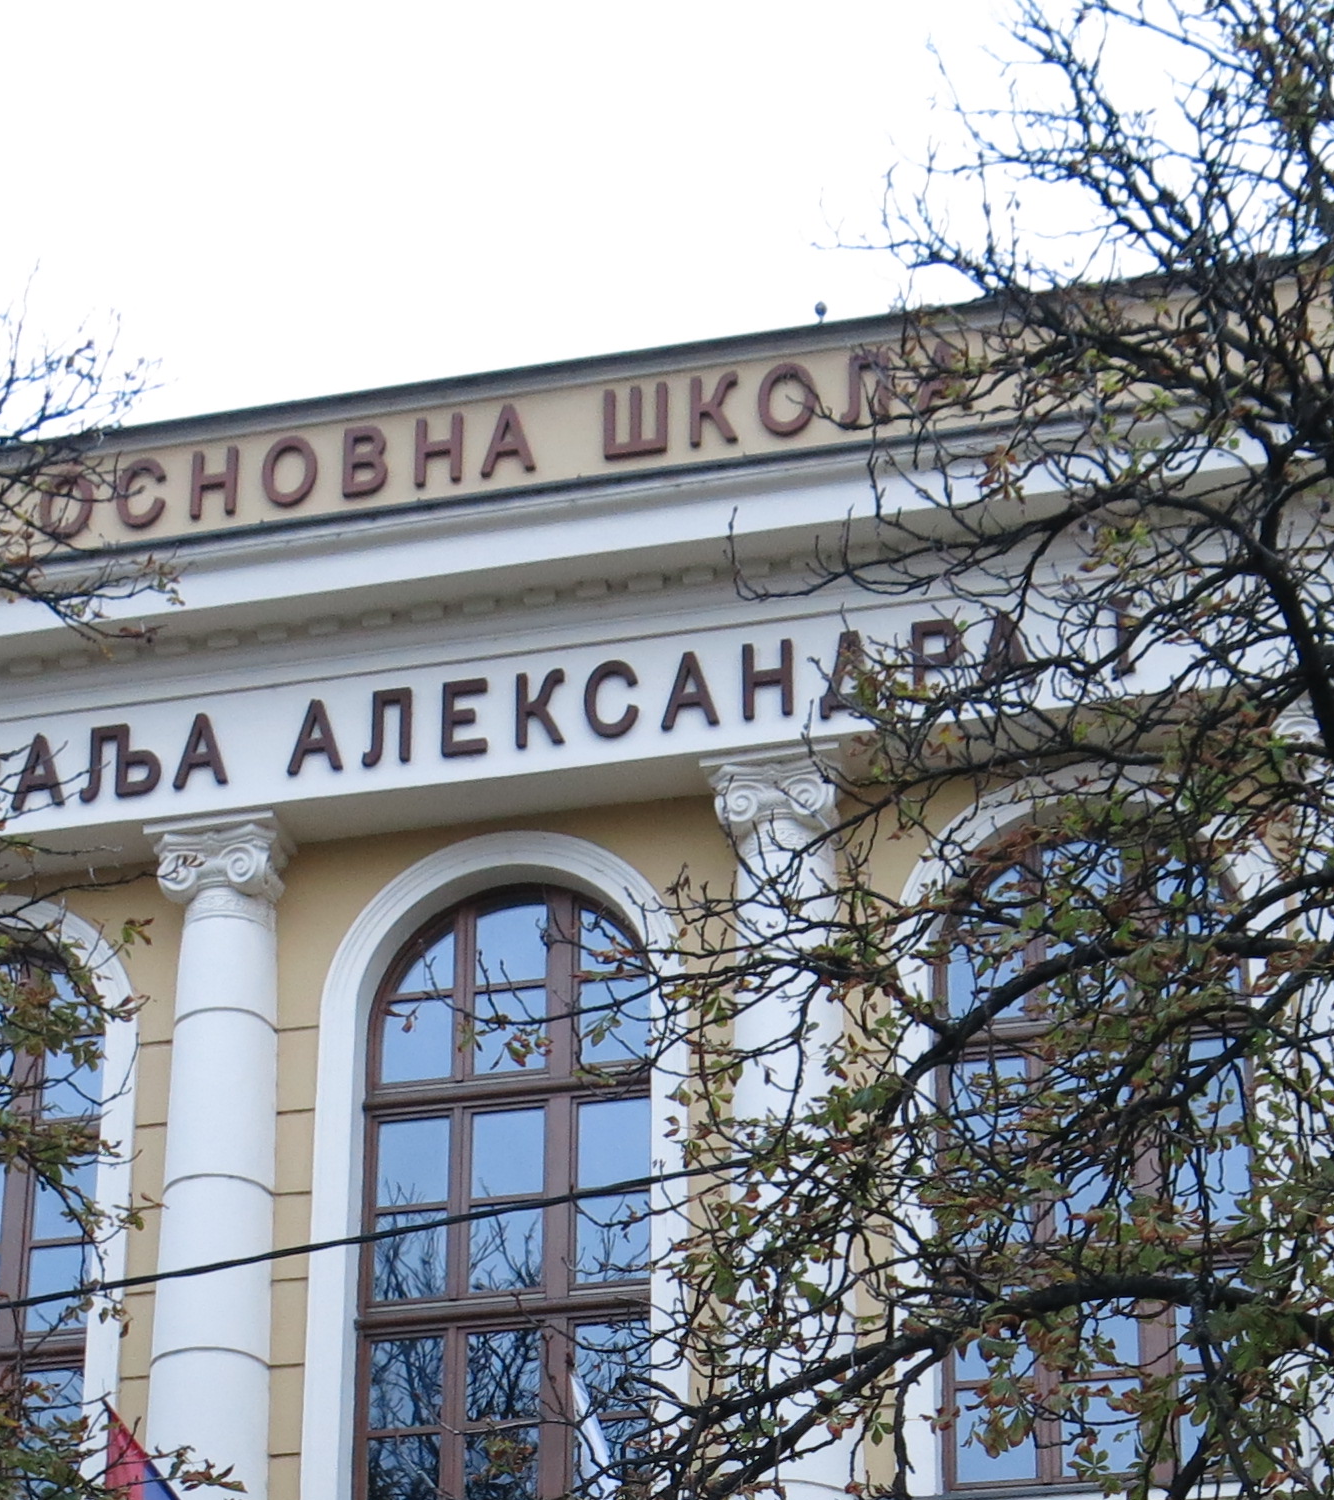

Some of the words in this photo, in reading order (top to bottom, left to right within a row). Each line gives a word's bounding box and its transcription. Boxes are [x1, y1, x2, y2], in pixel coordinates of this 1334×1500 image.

[38, 402, 538, 538] ОСНОВНА
[603, 341, 972, 461] ШКОЛА
[287, 610, 1037, 778] АЛЕКСАНДРА
